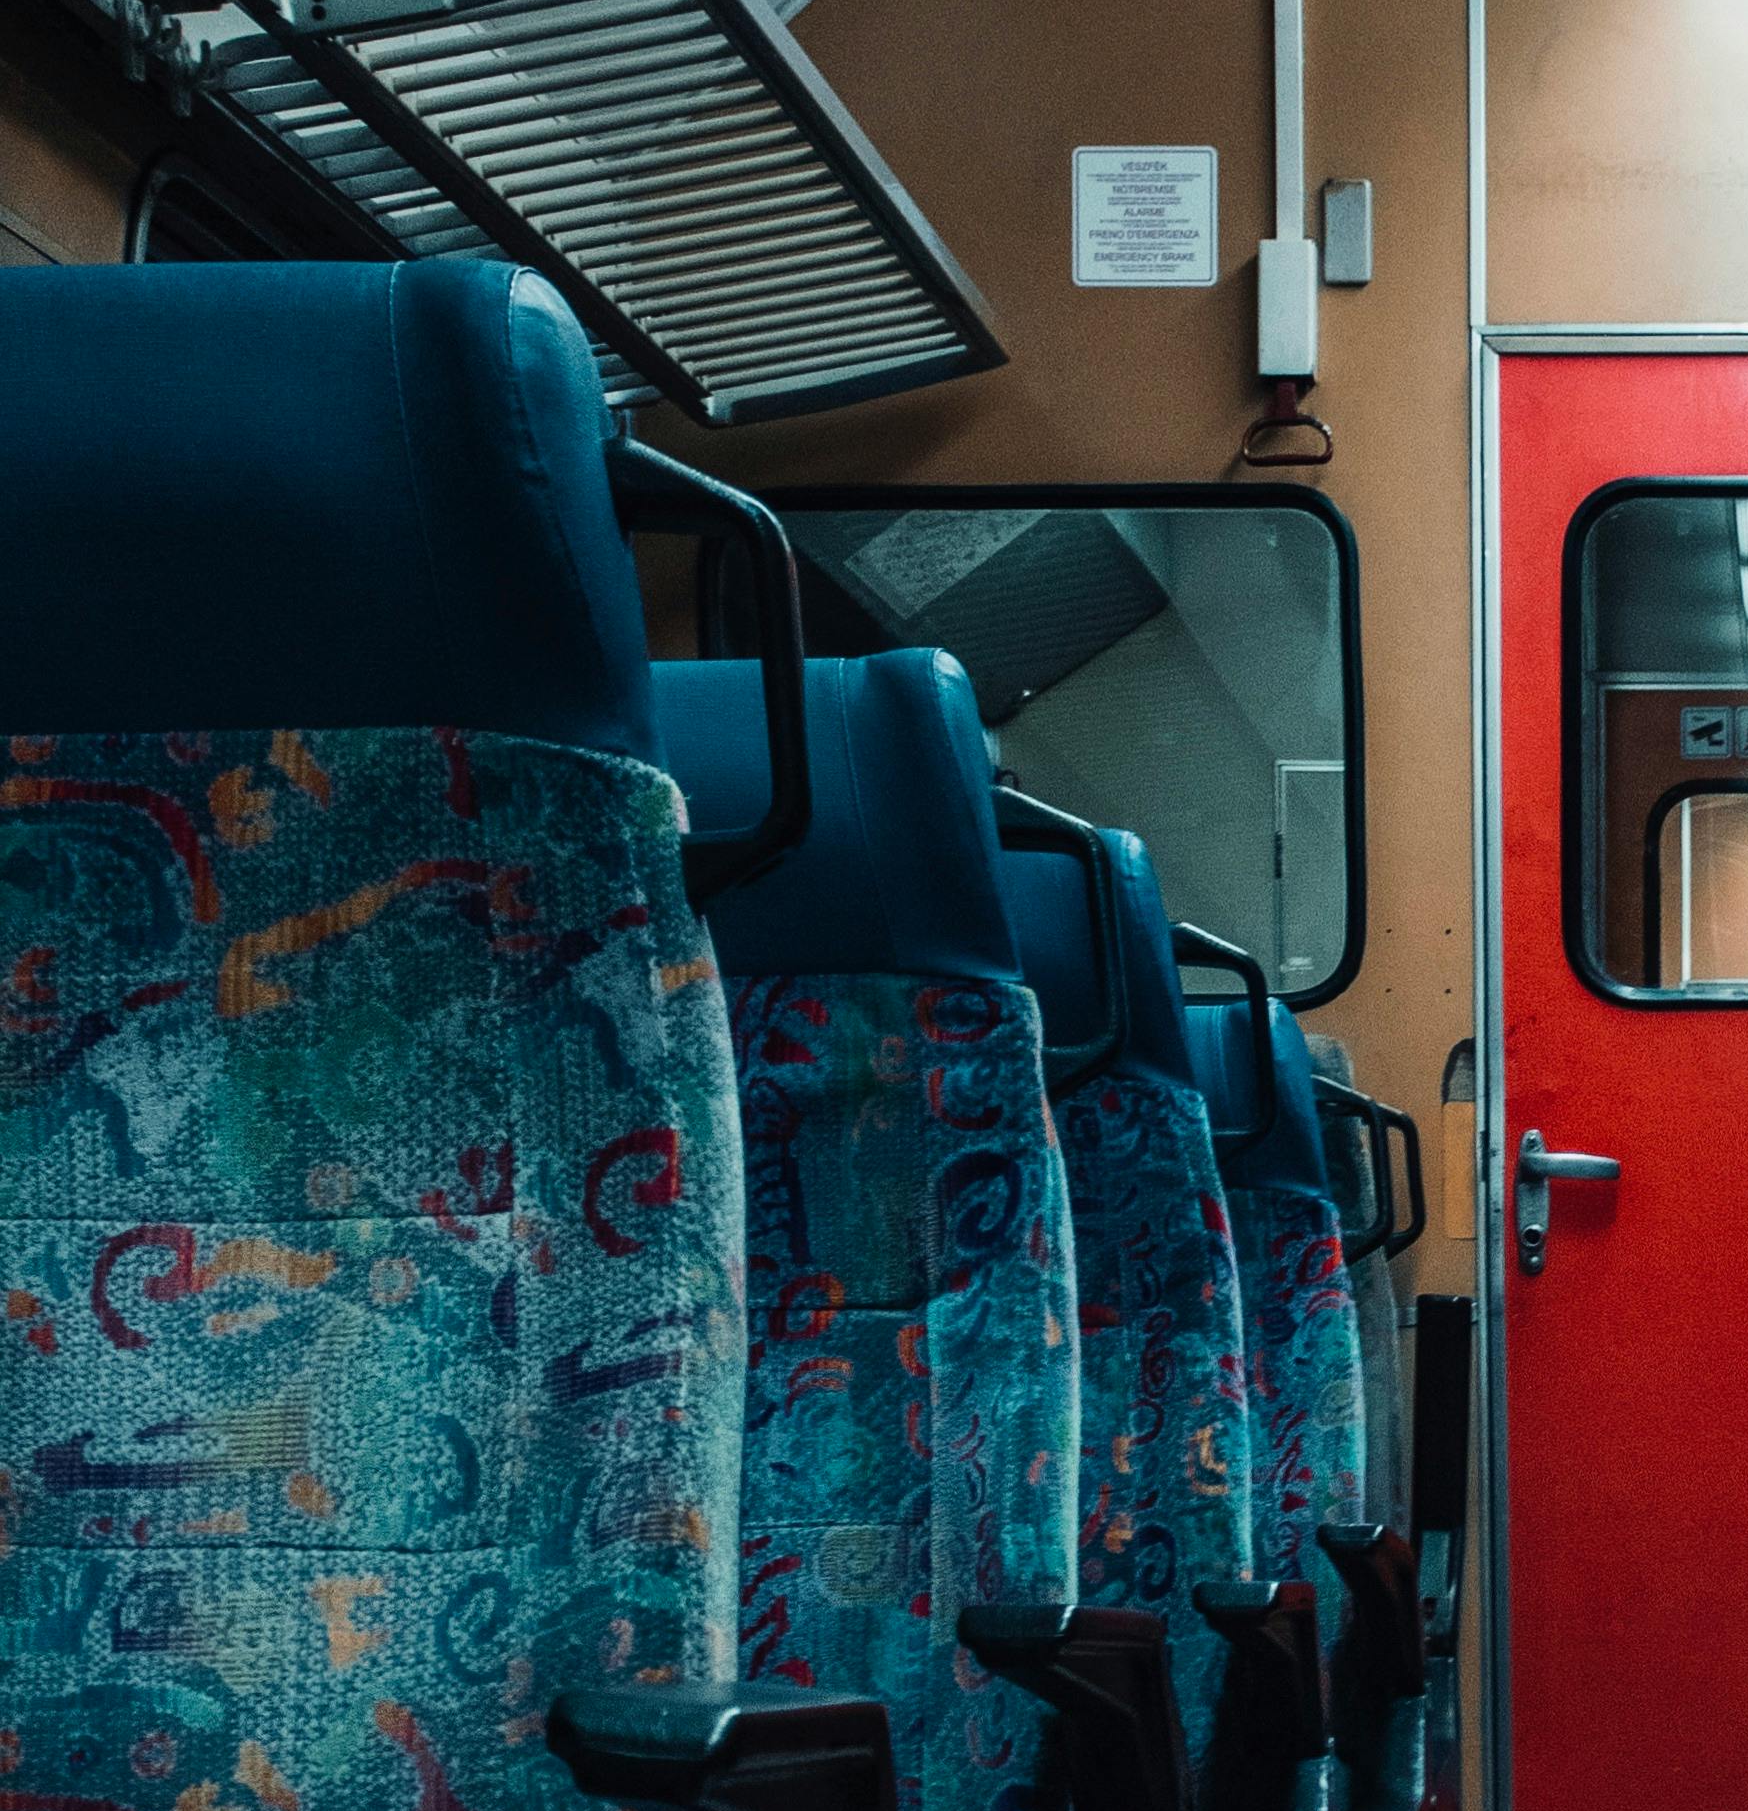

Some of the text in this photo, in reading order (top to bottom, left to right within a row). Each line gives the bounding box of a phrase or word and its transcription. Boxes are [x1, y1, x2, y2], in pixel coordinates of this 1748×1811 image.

[1112, 185, 1177, 194] NOTBREMSE
[1123, 207, 1165, 217] ALARME
[1088, 230, 1125, 239] FRENO
[1094, 252, 1195, 261] EMERGENCY BRAKE
